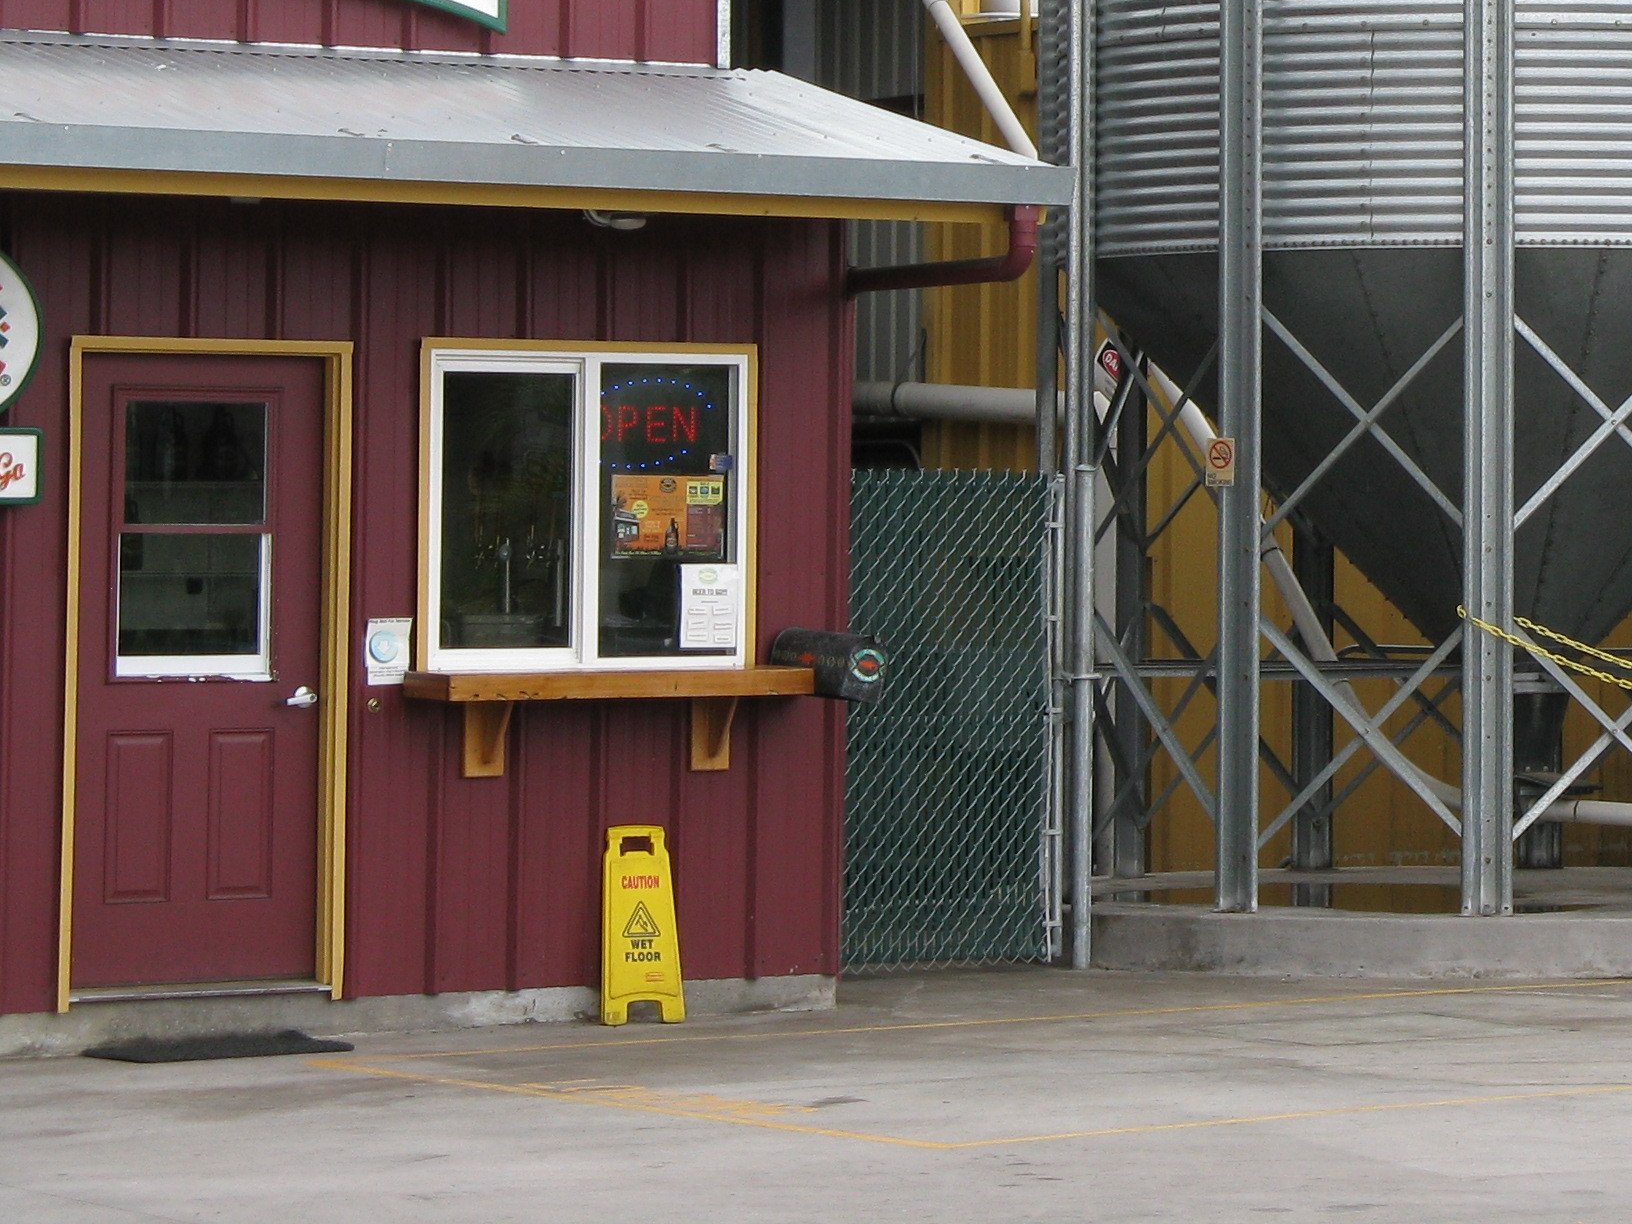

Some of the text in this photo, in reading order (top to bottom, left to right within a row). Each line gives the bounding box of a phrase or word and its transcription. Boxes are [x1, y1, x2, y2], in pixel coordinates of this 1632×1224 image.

[621, 875, 660, 890] CAUTION
[630, 938, 654, 950] WET
[624, 951, 662, 963] FLOOR
